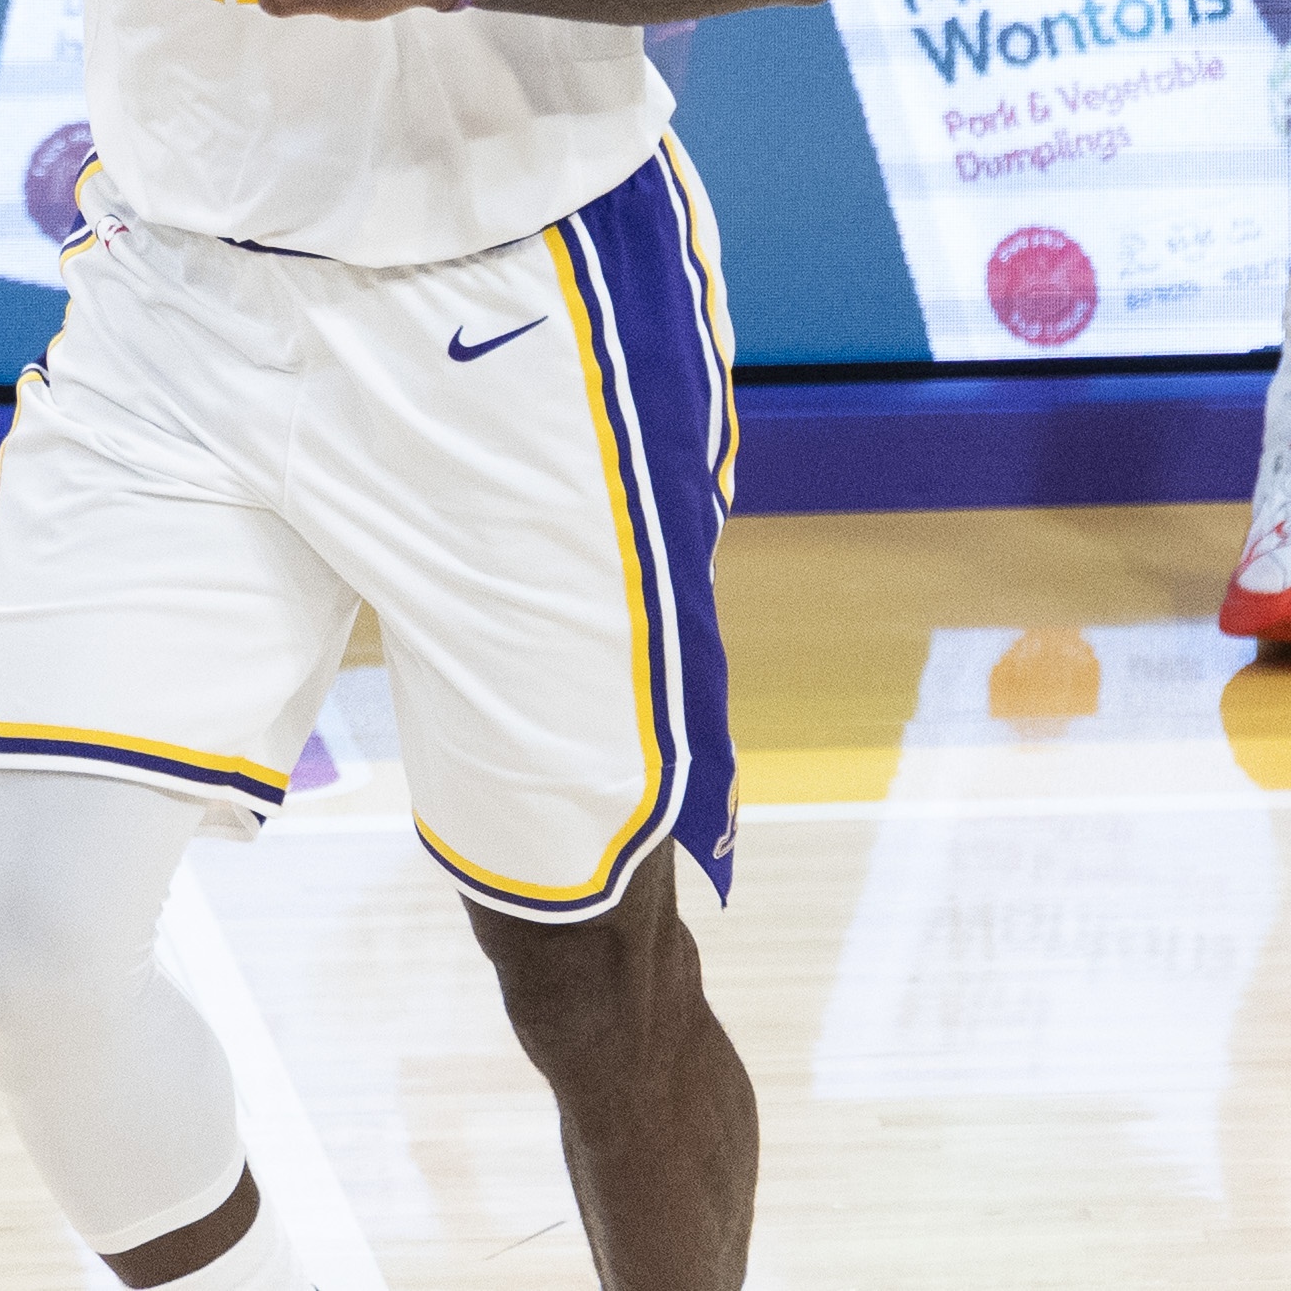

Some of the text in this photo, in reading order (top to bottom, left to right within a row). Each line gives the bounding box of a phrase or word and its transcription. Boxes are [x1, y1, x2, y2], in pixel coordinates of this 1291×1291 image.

[942, 50, 1226, 141] Pork & Vegetable
[955, 125, 1133, 183] Dumplings
